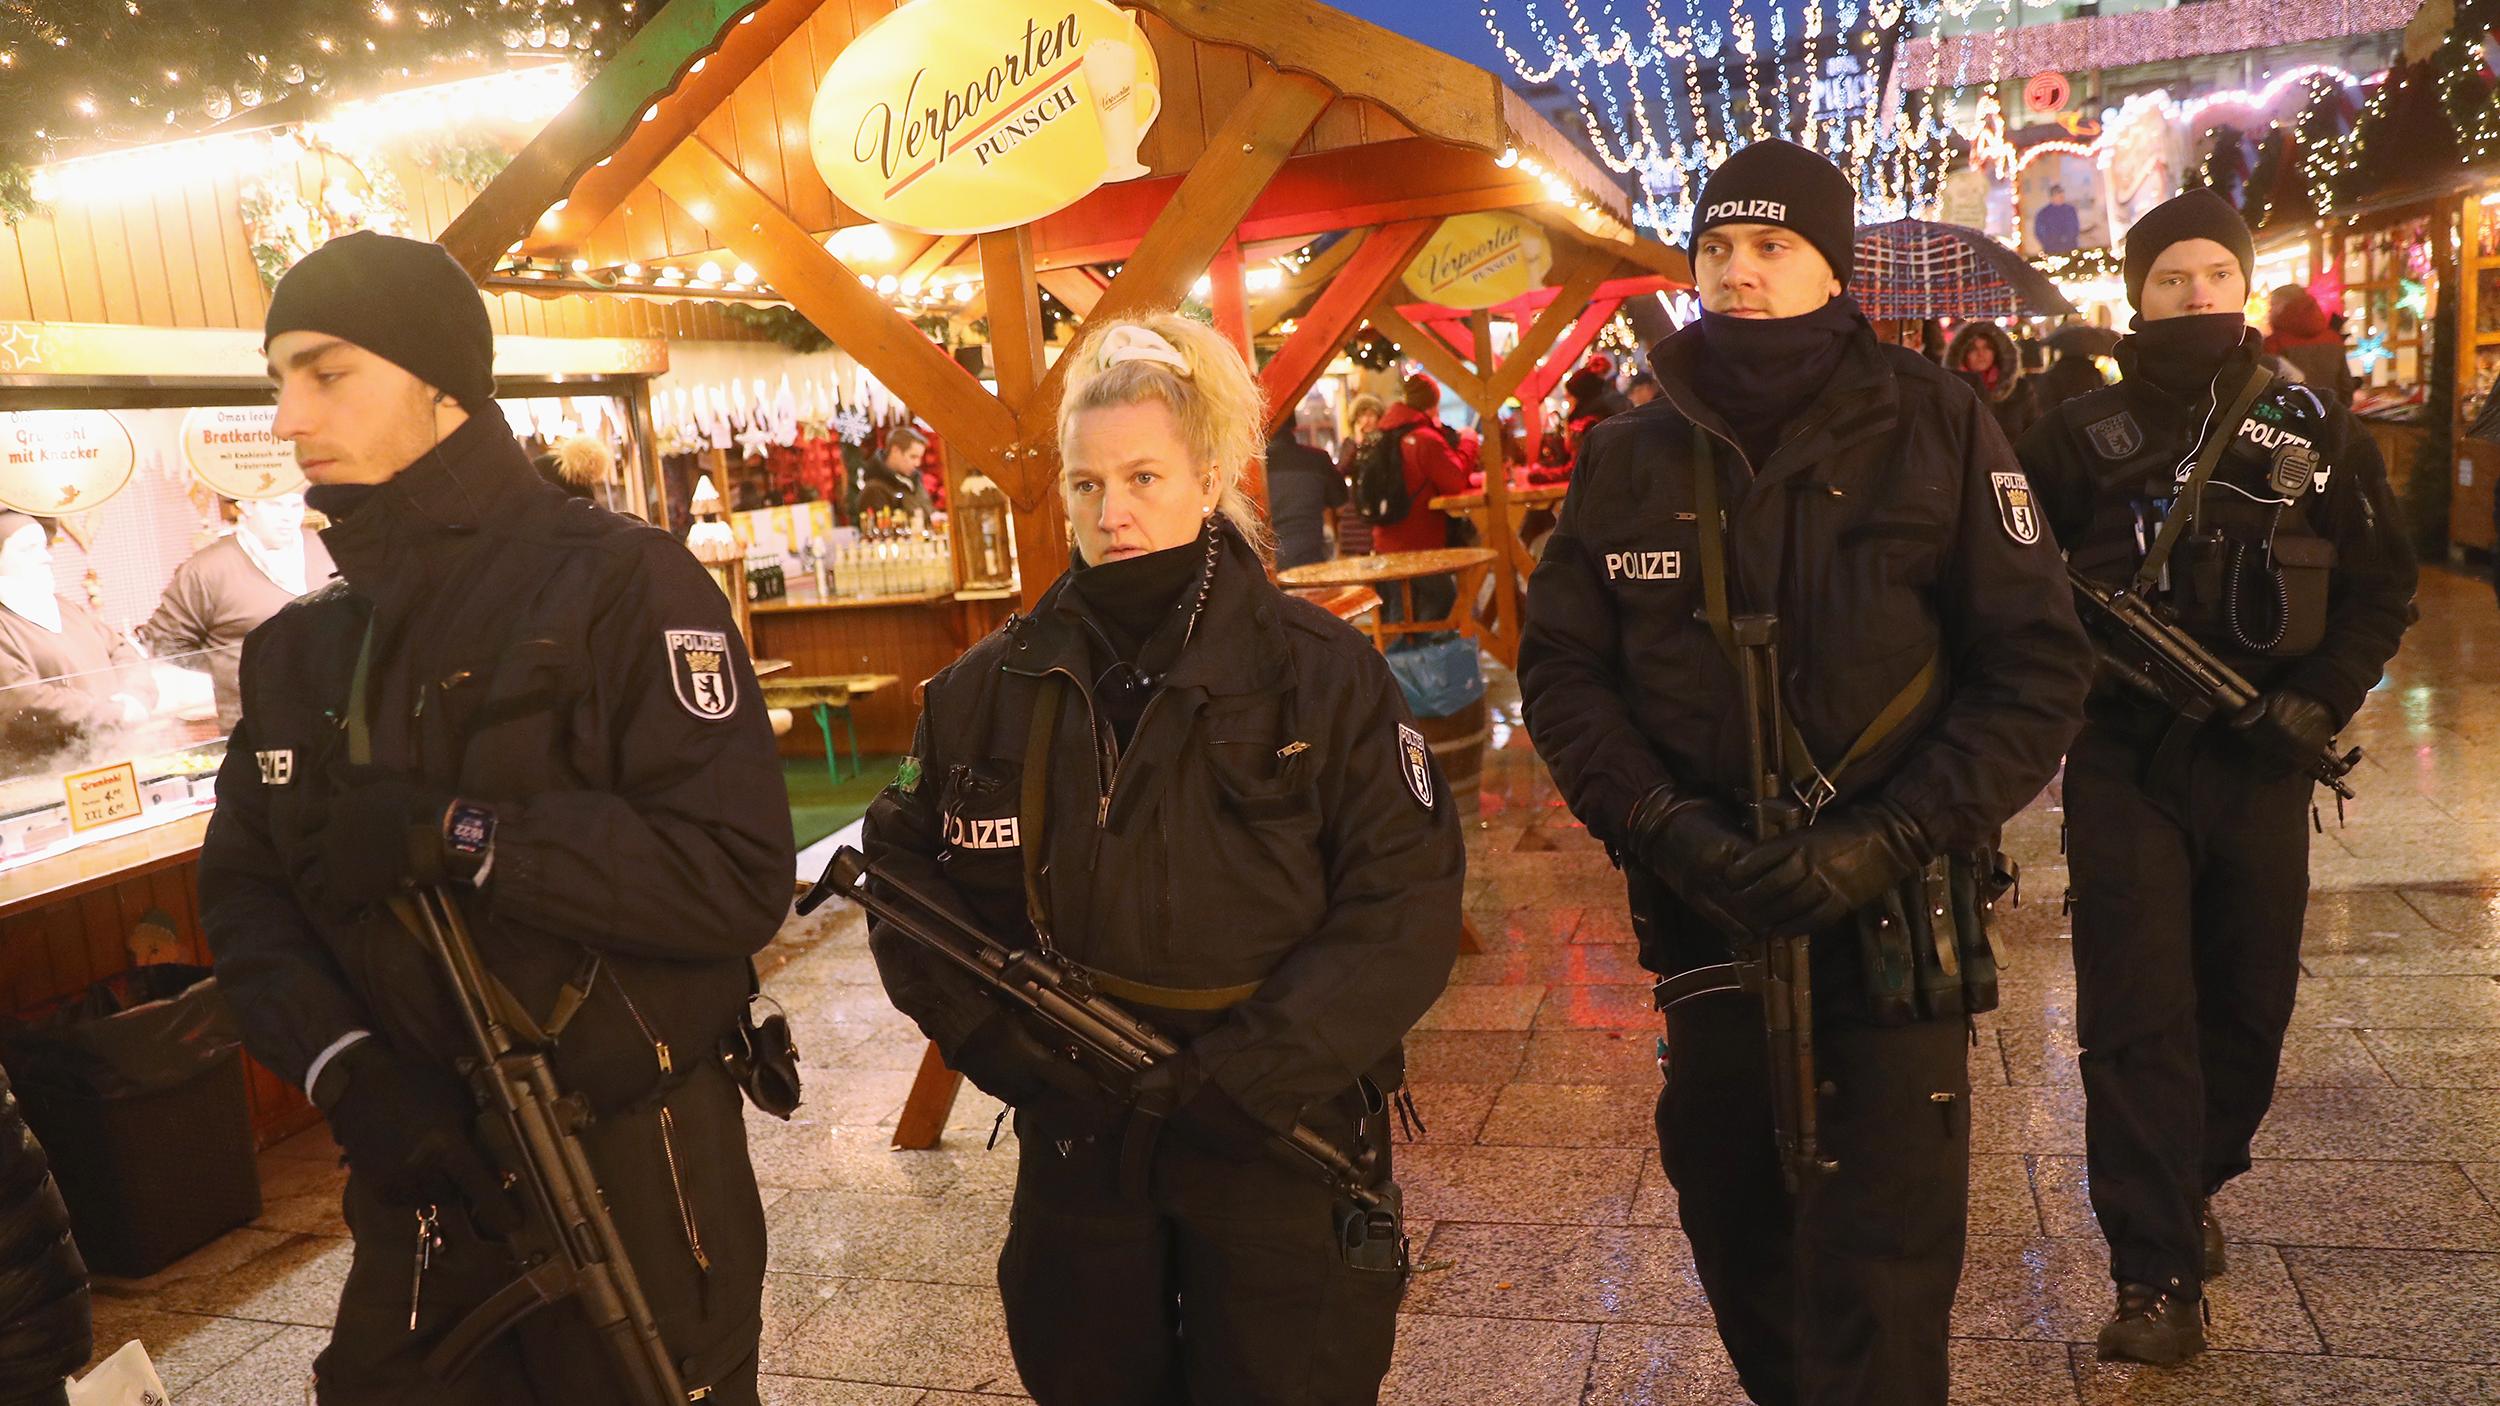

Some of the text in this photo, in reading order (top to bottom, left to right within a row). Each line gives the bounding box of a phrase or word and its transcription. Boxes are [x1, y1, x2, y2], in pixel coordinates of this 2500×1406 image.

[854, 13, 1082, 180] Verpoorten
[974, 83, 1079, 167] PUNSCH
[1704, 199, 1787, 224] POLIZEI
[1418, 224, 1521, 286] Verpoorten
[9, 446, 99, 464] mit Knacker
[1605, 551, 1681, 580] POLIZEI
[671, 634, 725, 653] POLIZEI
